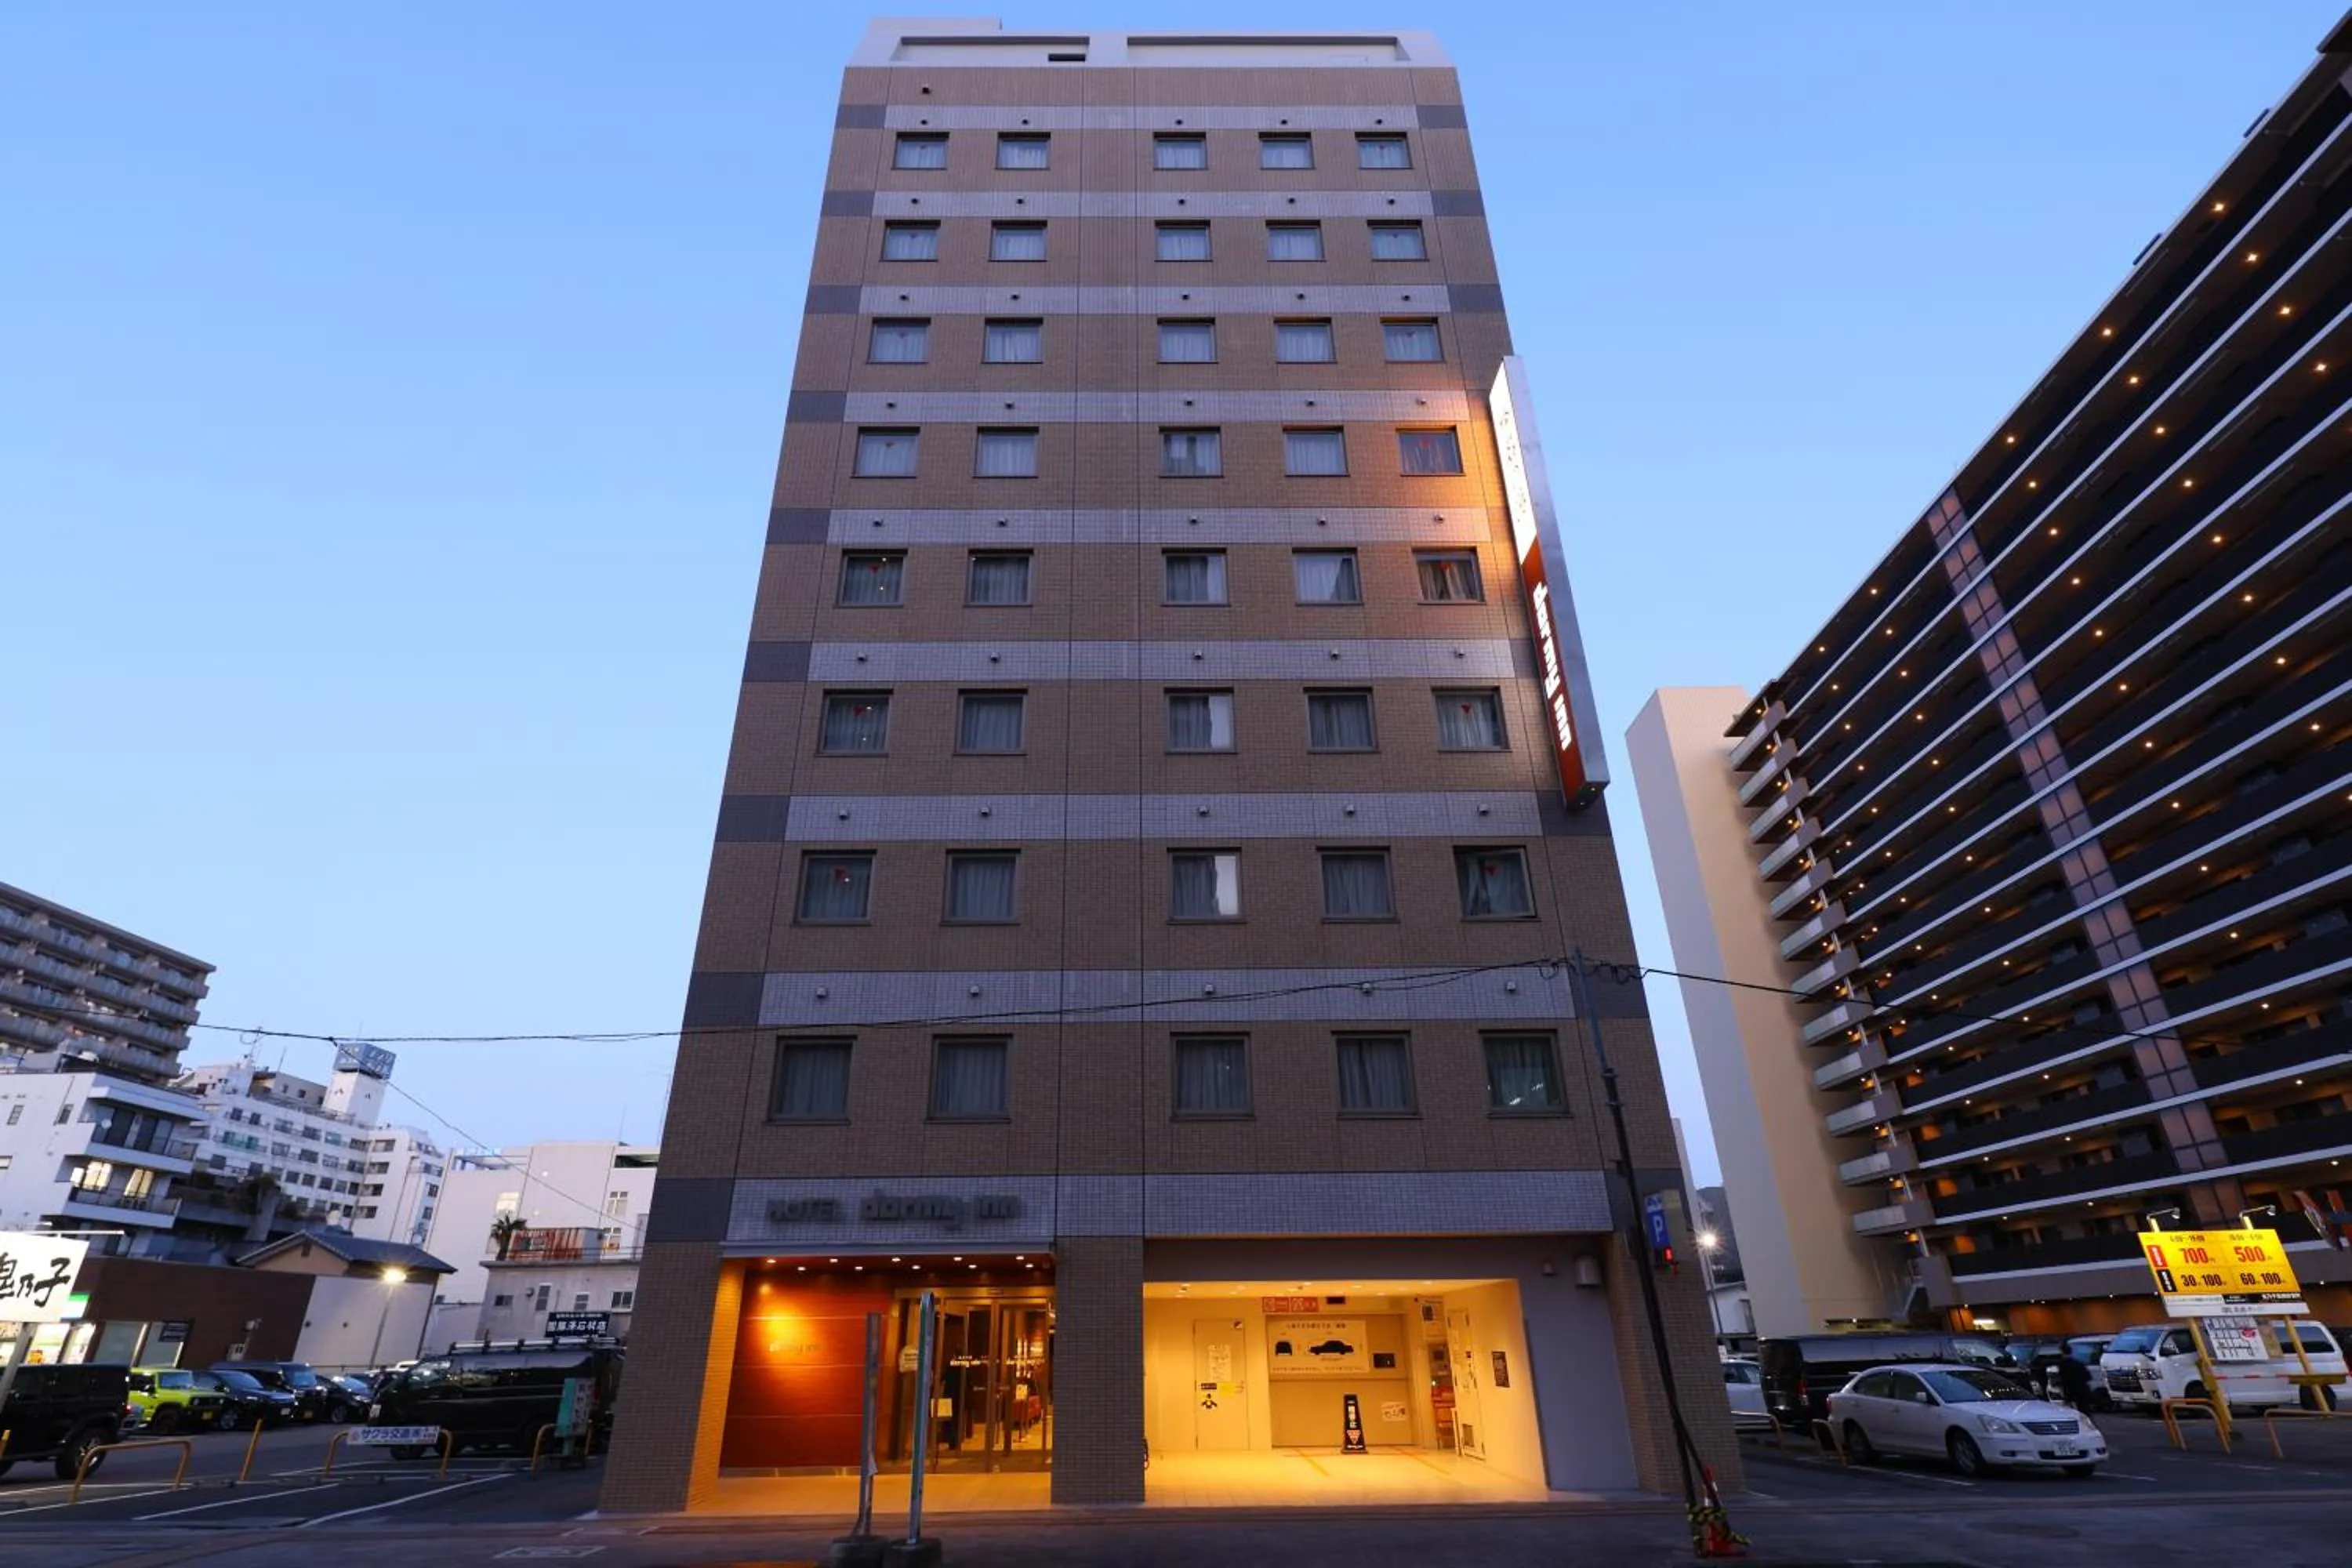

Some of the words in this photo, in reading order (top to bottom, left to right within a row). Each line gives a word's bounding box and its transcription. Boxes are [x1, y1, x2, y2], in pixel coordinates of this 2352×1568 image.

[1534, 582, 1560, 699] dormy
[1554, 694, 1572, 750] inn
[1653, 1215, 1663, 1242] P
